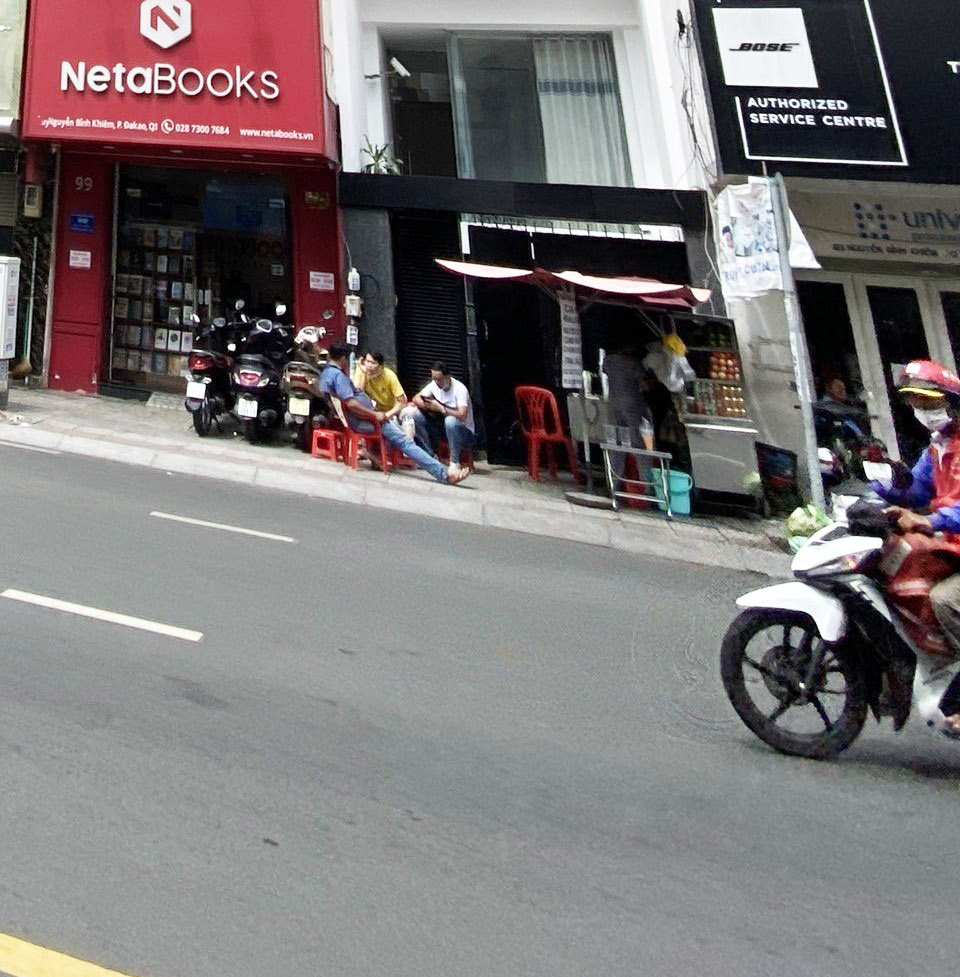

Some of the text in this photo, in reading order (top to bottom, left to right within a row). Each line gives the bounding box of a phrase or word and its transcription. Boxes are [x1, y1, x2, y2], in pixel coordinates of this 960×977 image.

[729, 42, 801, 52] BOSE
[60, 61, 280, 100] NetaBooks
[747, 97, 849, 110] AUTHORIZED
[750, 113, 888, 129] SERVICE CENTRE
[148, 122, 158, 132] Q1
[175, 123, 190, 133] 028
[191, 124, 210, 134] 7300
[211, 125, 230, 135] 7684
[240, 127, 314, 141] www.netabooks.vn
[75, 176, 94, 192] 99
